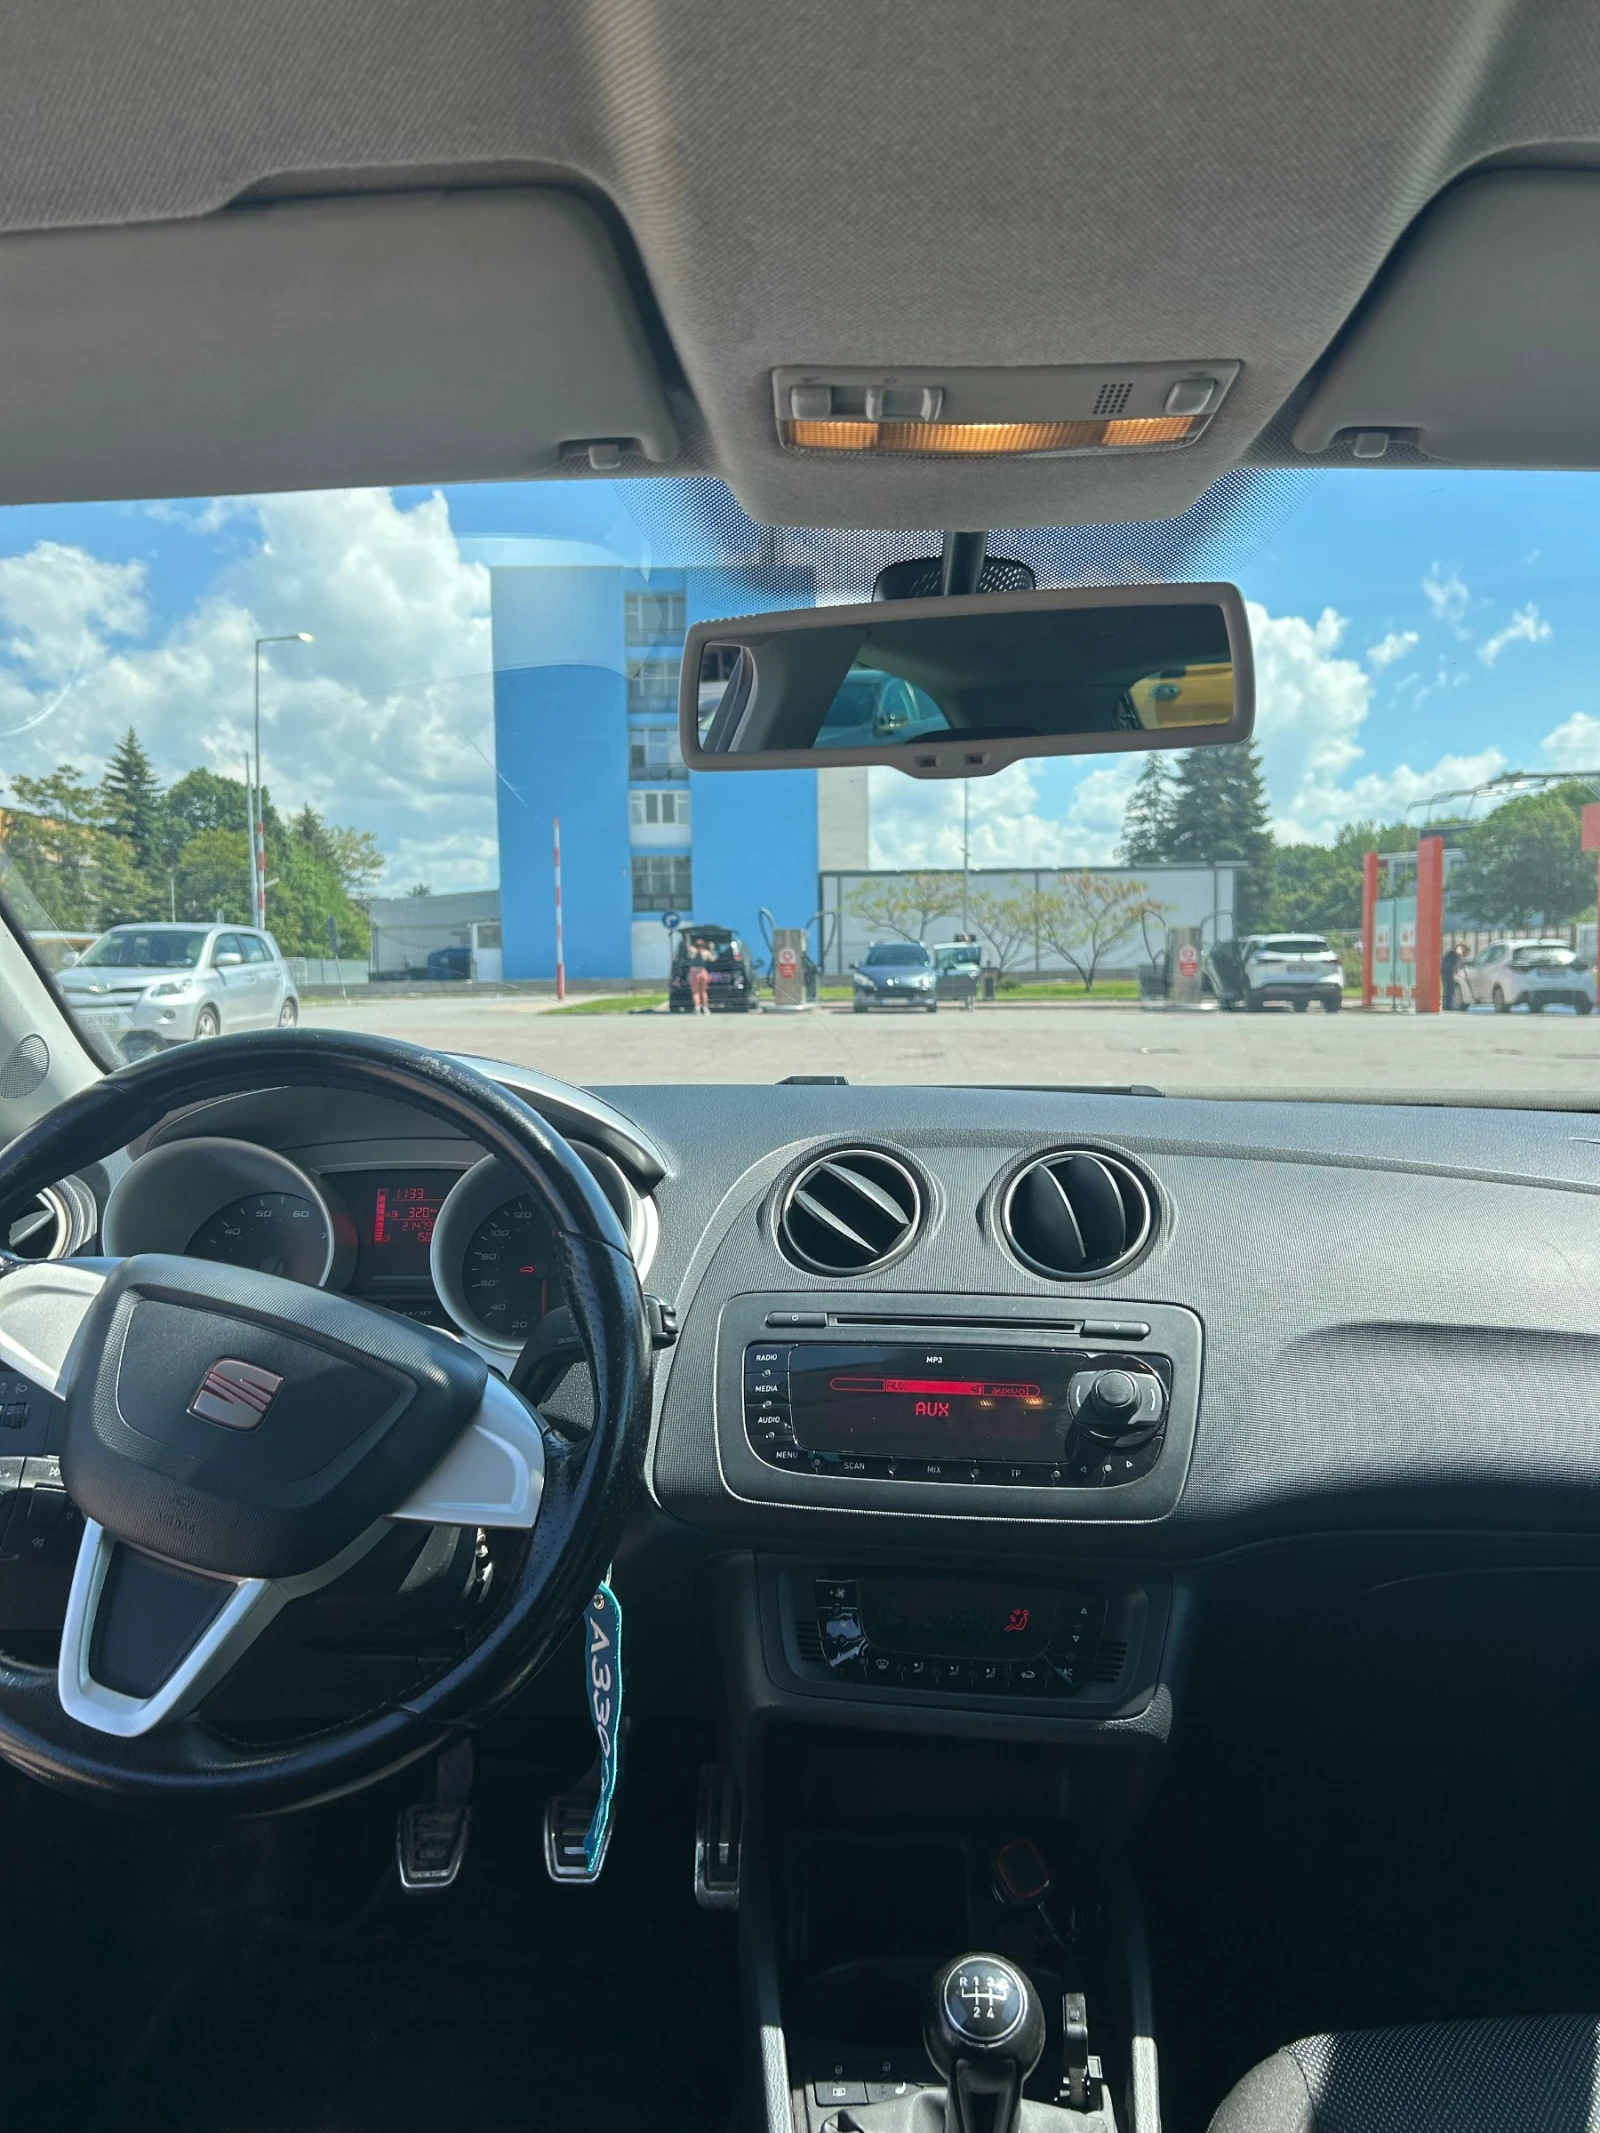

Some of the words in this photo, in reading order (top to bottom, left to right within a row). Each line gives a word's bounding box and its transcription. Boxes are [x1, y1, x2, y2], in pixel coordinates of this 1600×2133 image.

[255, 1210, 272, 1218] 50
[292, 1210, 310, 1218] 60
[408, 1206, 430, 1218] 320
[513, 1211, 532, 1219] 120
[224, 1227, 241, 1236] 40
[490, 1229, 509, 1237] 100
[490, 1303, 506, 1311] 40
[511, 1320, 528, 1328] 20
[755, 1353, 778, 1362] RADIO
[925, 1355, 943, 1364] MP3
[886, 1379, 908, 1391] AUX
[914, 1401, 949, 1417] AUX
[757, 1416, 781, 1424] AUDIO
[775, 1451, 799, 1459] MENU
[843, 1461, 866, 1471] SCAN
[926, 1465, 942, 1475] MIX
[1010, 1469, 1022, 1478] TP
[959, 1976, 968, 1987] R
[973, 1975, 980, 1987] 1
[986, 1976, 995, 1987] 3
[973, 2006, 981, 2018] 2
[986, 2007, 995, 2019] 4
